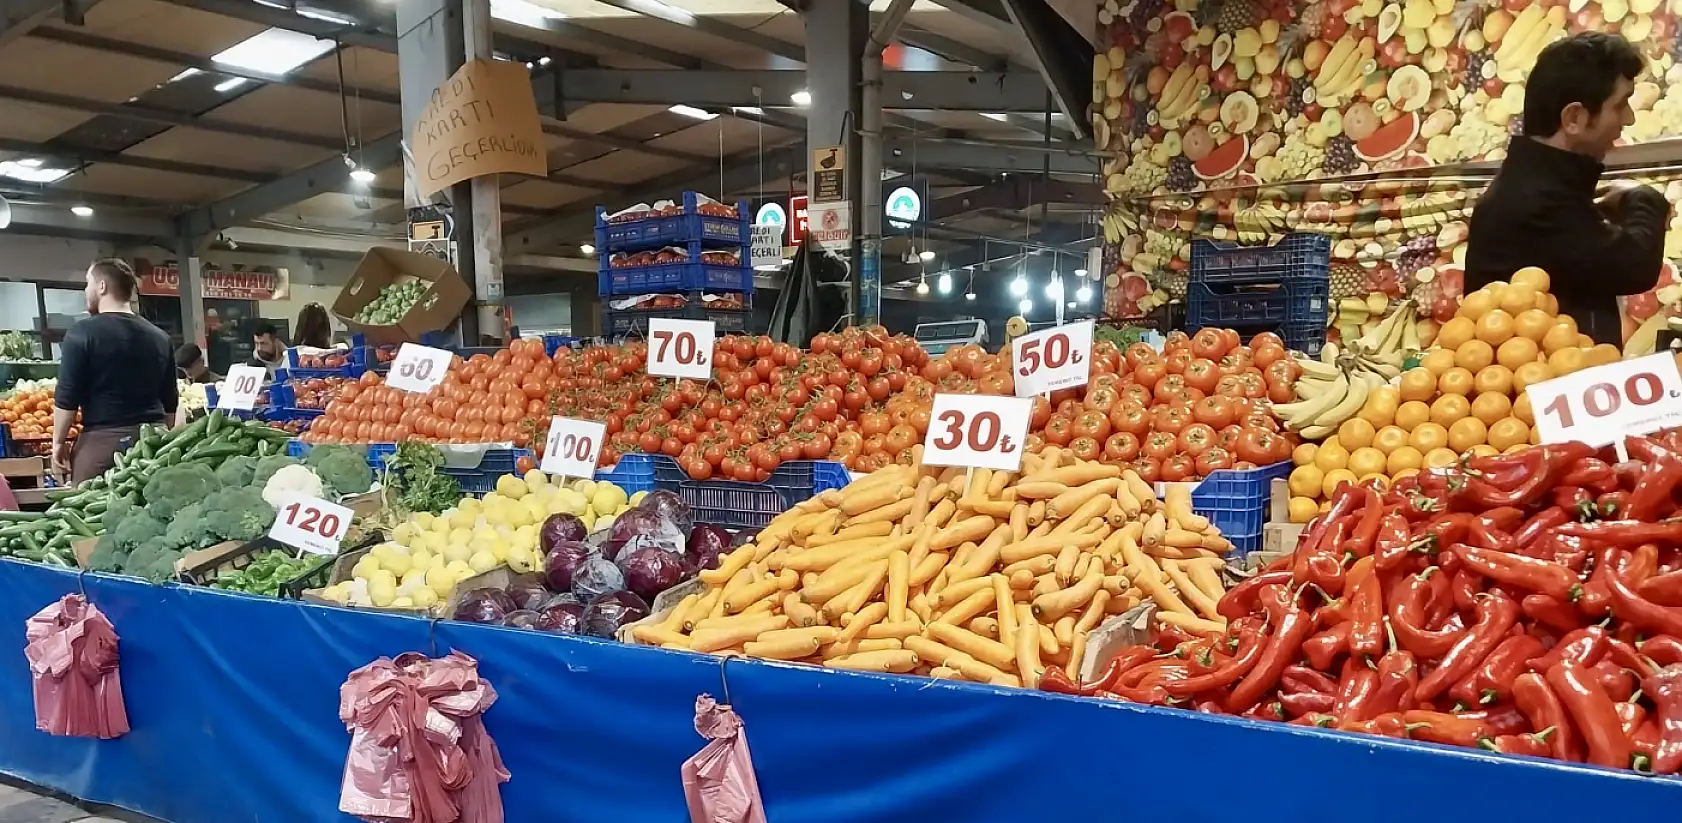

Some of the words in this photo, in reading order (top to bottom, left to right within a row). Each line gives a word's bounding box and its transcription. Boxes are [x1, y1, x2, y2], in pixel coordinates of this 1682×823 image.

[426, 100, 494, 146] KARTI
[653, 330, 707, 366] 70₺
[1019, 333, 1083, 377] 50₺
[933, 409, 1016, 454] 30₺
